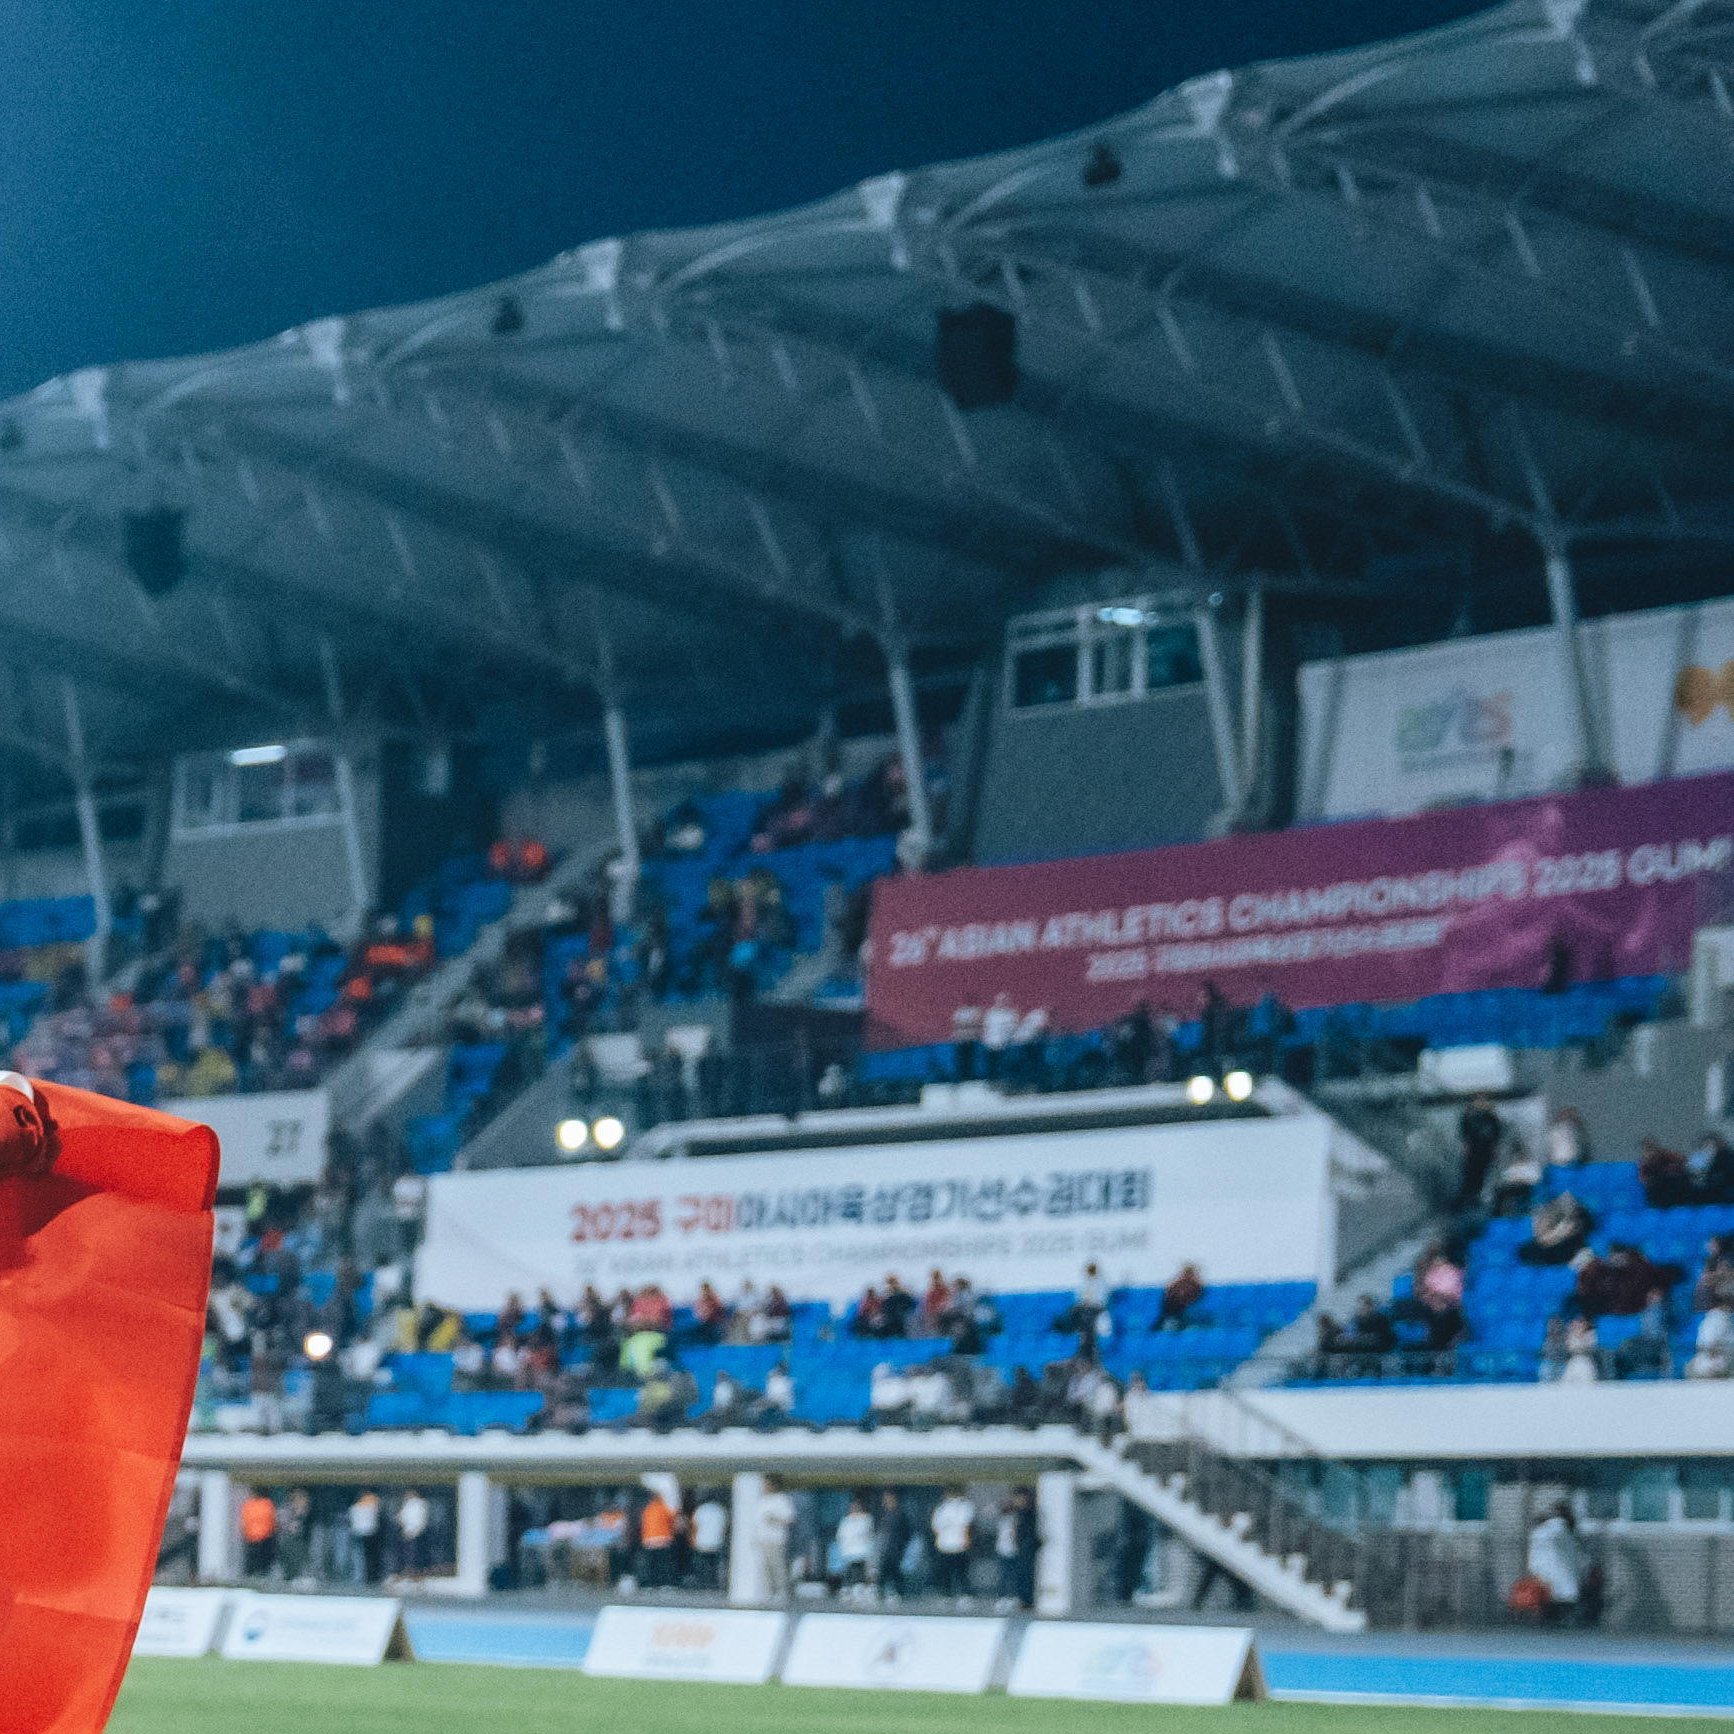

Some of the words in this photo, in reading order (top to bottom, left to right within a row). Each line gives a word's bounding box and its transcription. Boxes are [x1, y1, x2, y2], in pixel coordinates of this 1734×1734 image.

[938, 920, 1037, 960] ASIAN
[1041, 896, 1223, 948] ATHLETICS
[1230, 858, 1528, 928] CHAMPIONSHIPS
[1533, 849, 1622, 898] 2025
[571, 1198, 661, 1242] 2025
